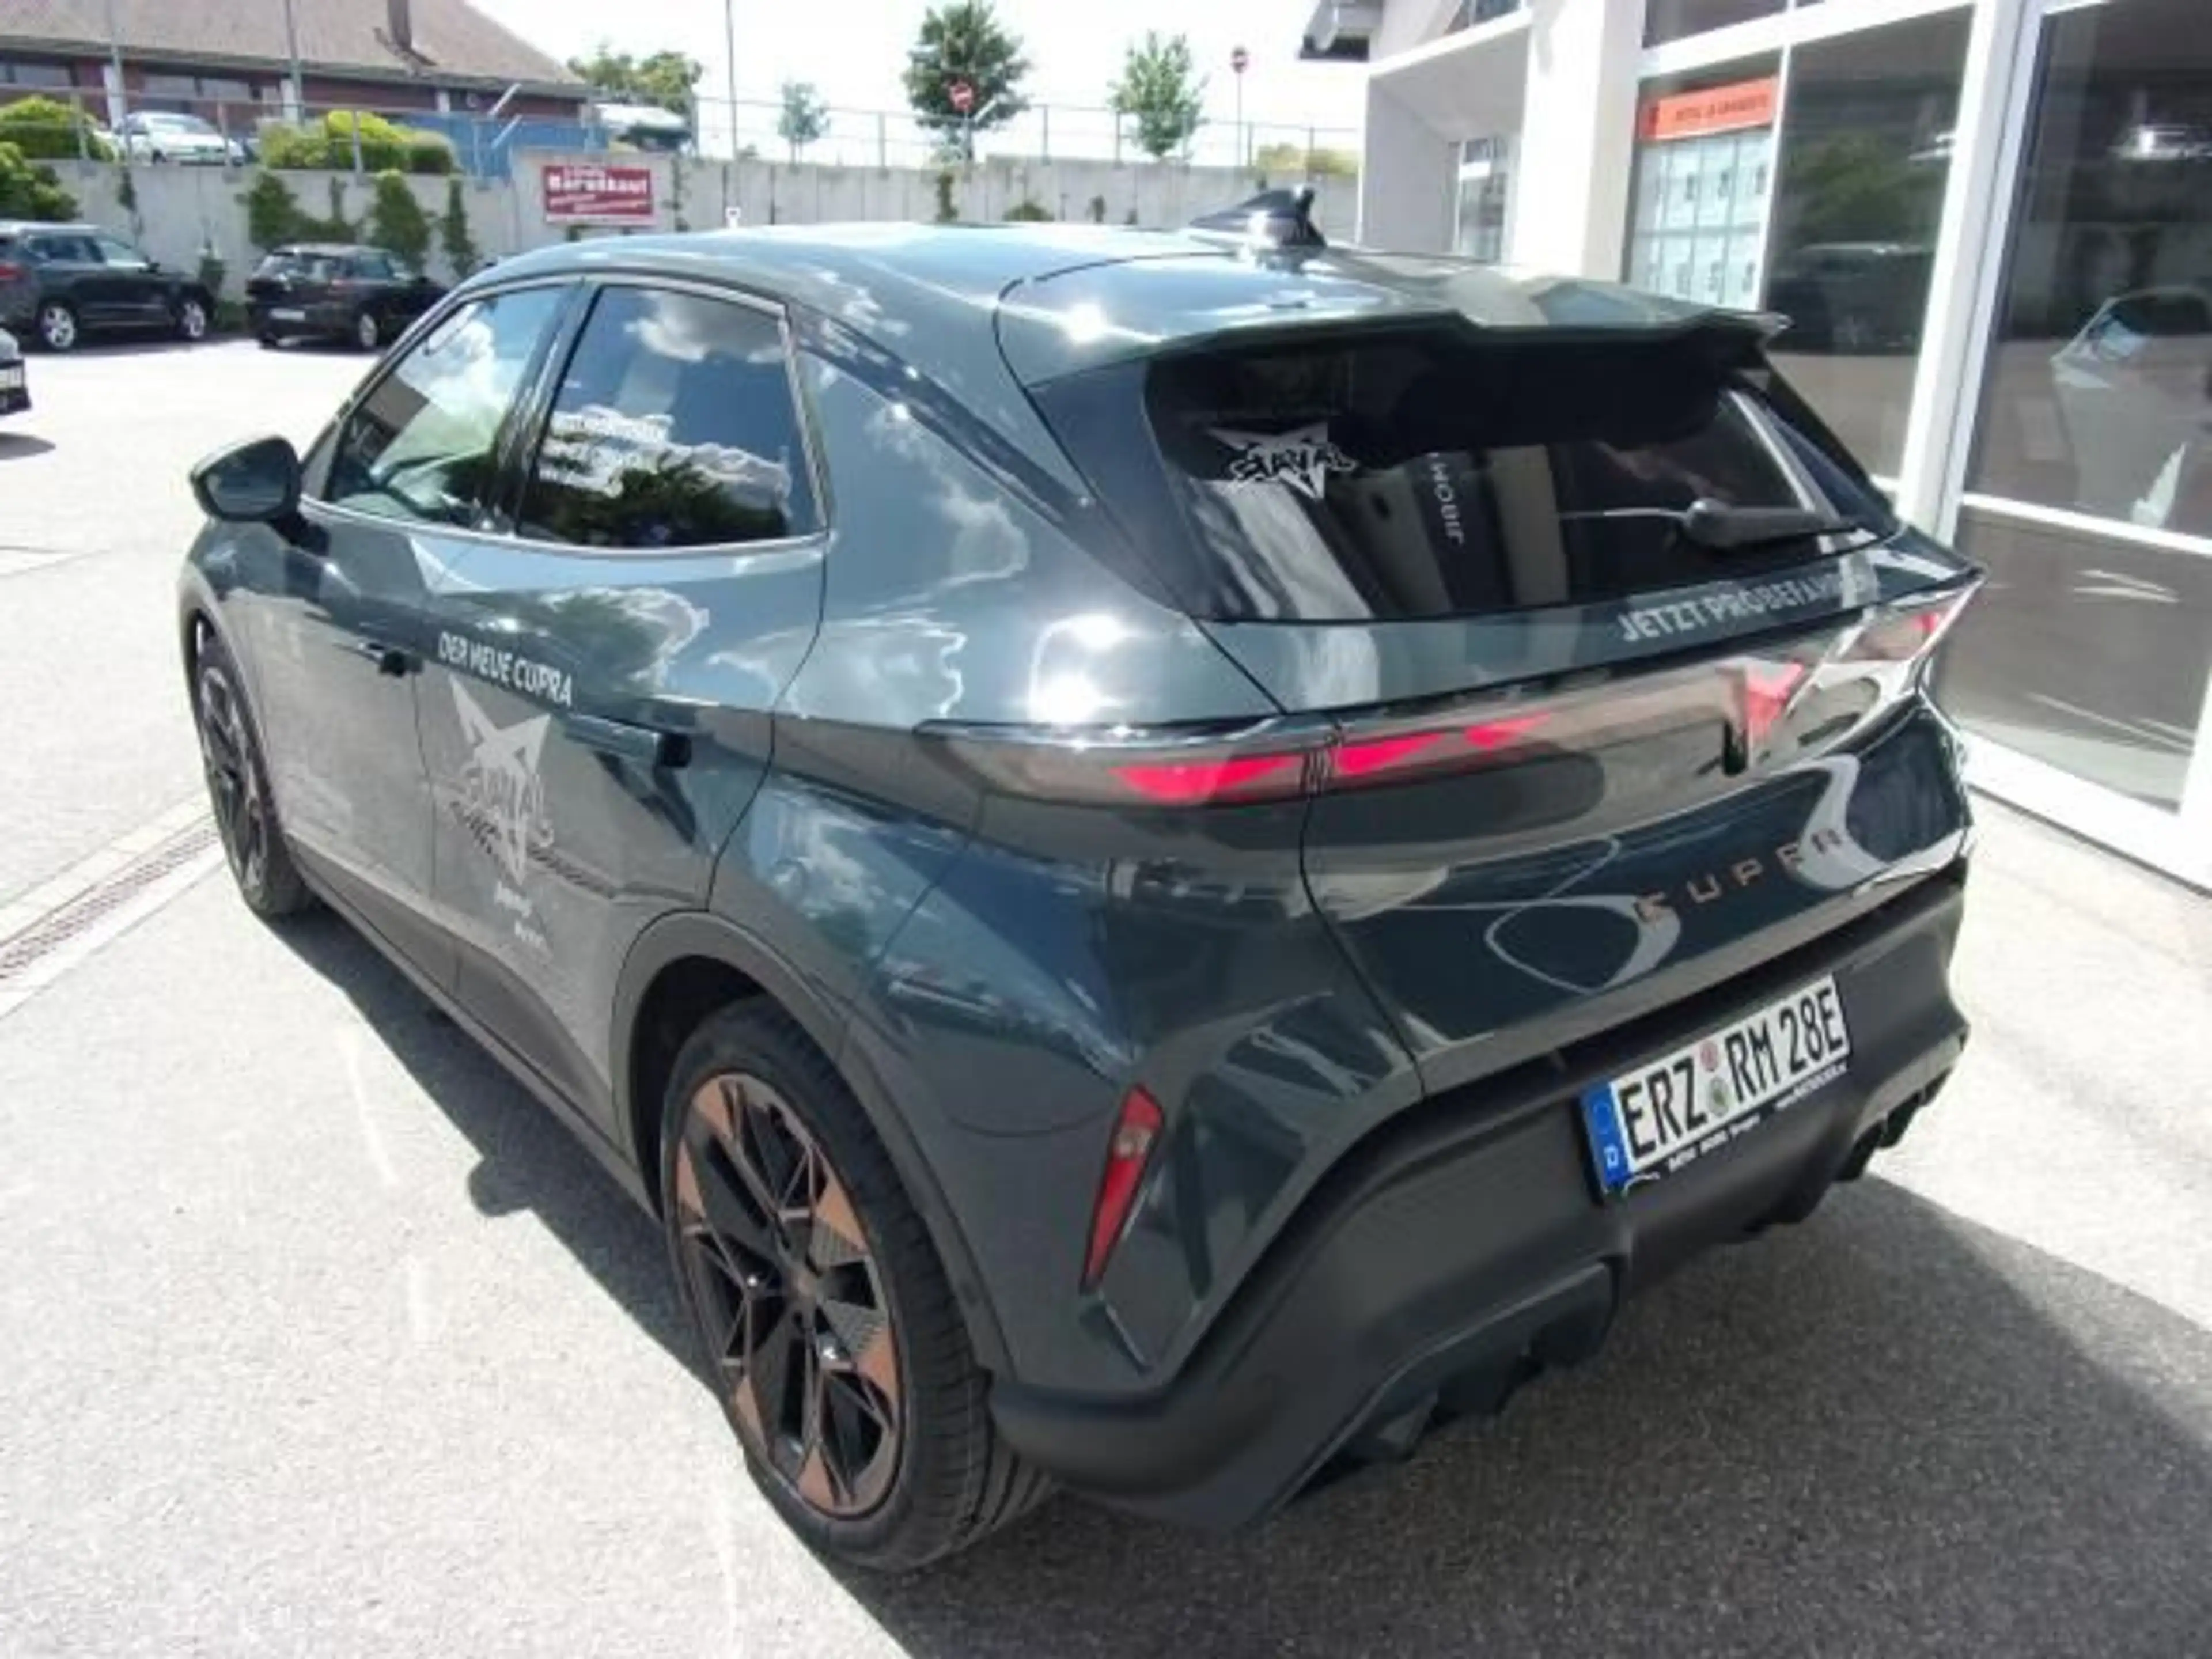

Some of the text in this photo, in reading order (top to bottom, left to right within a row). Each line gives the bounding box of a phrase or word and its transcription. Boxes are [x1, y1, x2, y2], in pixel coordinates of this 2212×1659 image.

[1616, 600, 1707, 642] JETZT
[438, 631, 573, 707] DER NEUE CUPRA
[1618, 1056, 1708, 1159] ERZ
[1725, 1018, 1780, 1104] RM
[1779, 986, 1843, 1075] 28E
